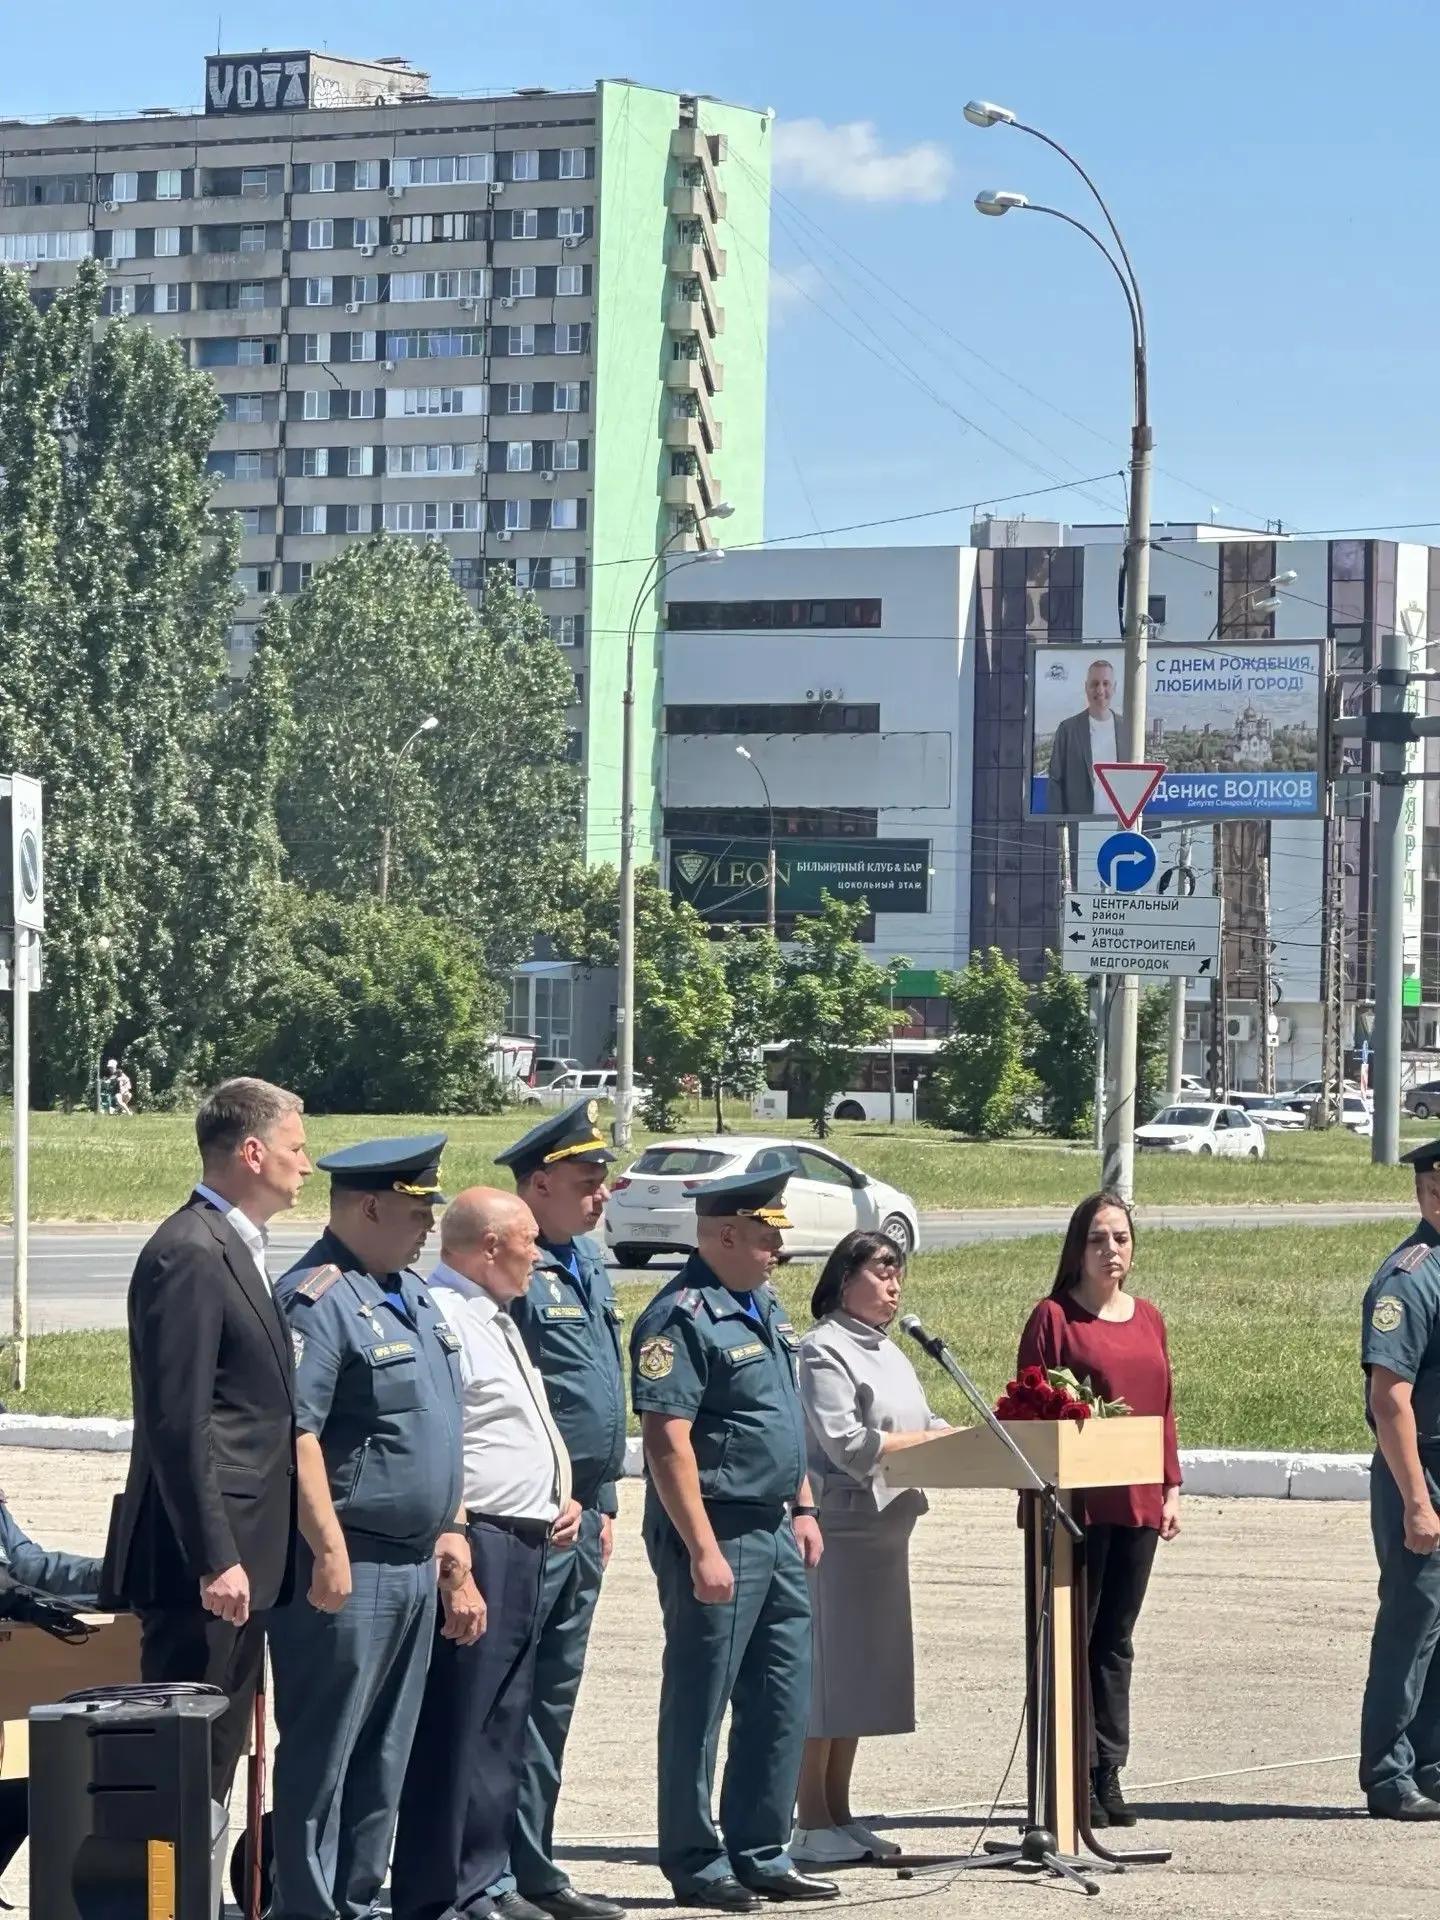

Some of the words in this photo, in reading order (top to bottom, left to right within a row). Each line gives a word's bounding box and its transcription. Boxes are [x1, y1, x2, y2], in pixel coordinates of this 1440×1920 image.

[1156, 659, 1166, 672] С
[1169, 659, 1215, 674] ДНЕМ
[1155, 675, 1243, 692] ЛЮБИМЫЙ
[1247, 676, 1305, 691] ГОРОД!
[1151, 780, 1218, 802] Денис
[1224, 780, 1313, 799] ВОЛКОВ
[797, 861, 866, 873] БИЛЬЯРДНЫЙ
[838, 880, 895, 890] ЦОКОЛЬНЫЙ
[1092, 898, 1179, 911] ЦЕНТРАЛЬНЫЙ
[1092, 910, 1125, 921] район
[1092, 926, 1124, 937] улица
[1091, 937, 1196, 951] АВТОСТРОИТЕЛЕЙ
[1090, 956, 1170, 971] МЕДГОРОДОК
